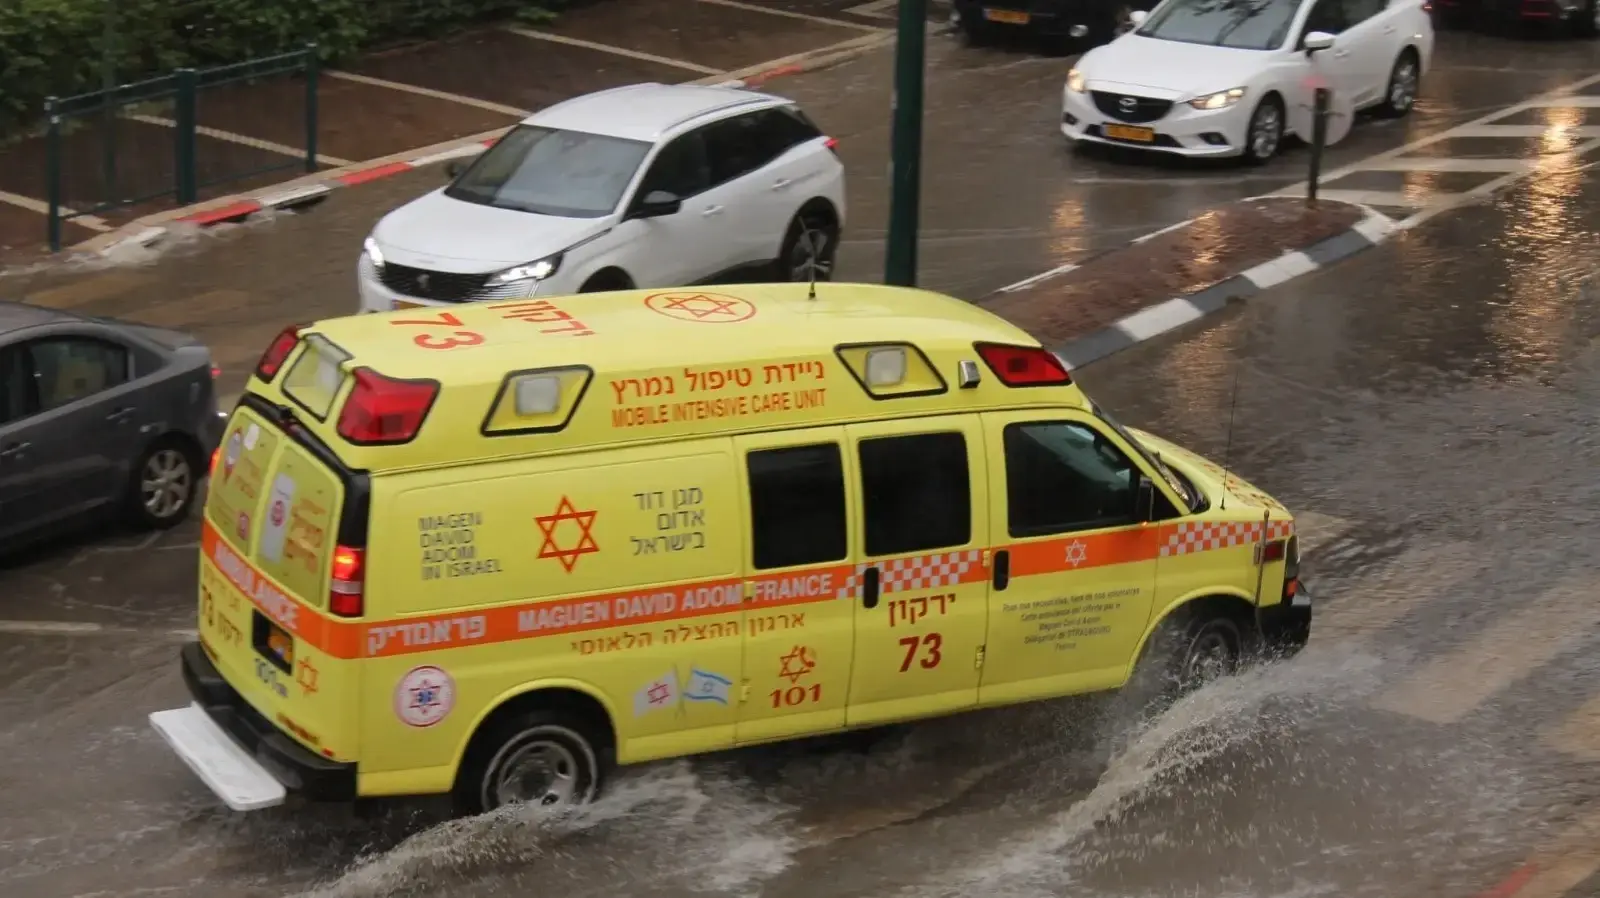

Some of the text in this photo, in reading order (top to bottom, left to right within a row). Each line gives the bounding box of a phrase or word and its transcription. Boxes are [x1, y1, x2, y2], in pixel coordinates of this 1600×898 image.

[389, 313, 485, 350] 73
[488, 300, 596, 337] ירקון
[609, 360, 825, 404] ניידת טיפול נמרץ
[611, 388, 826, 428] MOBILE INTENSIVE CARE UNIT
[632, 487, 703, 511] מגן דוד
[418, 511, 483, 531] MAGEN
[657, 508, 705, 532] אדום
[420, 528, 474, 548] DAVID
[629, 531, 705, 556] בישראל
[421, 545, 477, 564] ADOM
[421, 558, 503, 580] IN ISRAEL
[518, 573, 833, 632] MAGUEN DAVID ADOM FRANCE
[888, 593, 956, 627] ירקון
[571, 612, 806, 656] ארגון ההצלה הלאומי
[899, 632, 943, 673] 73
[769, 683, 822, 708] 101
